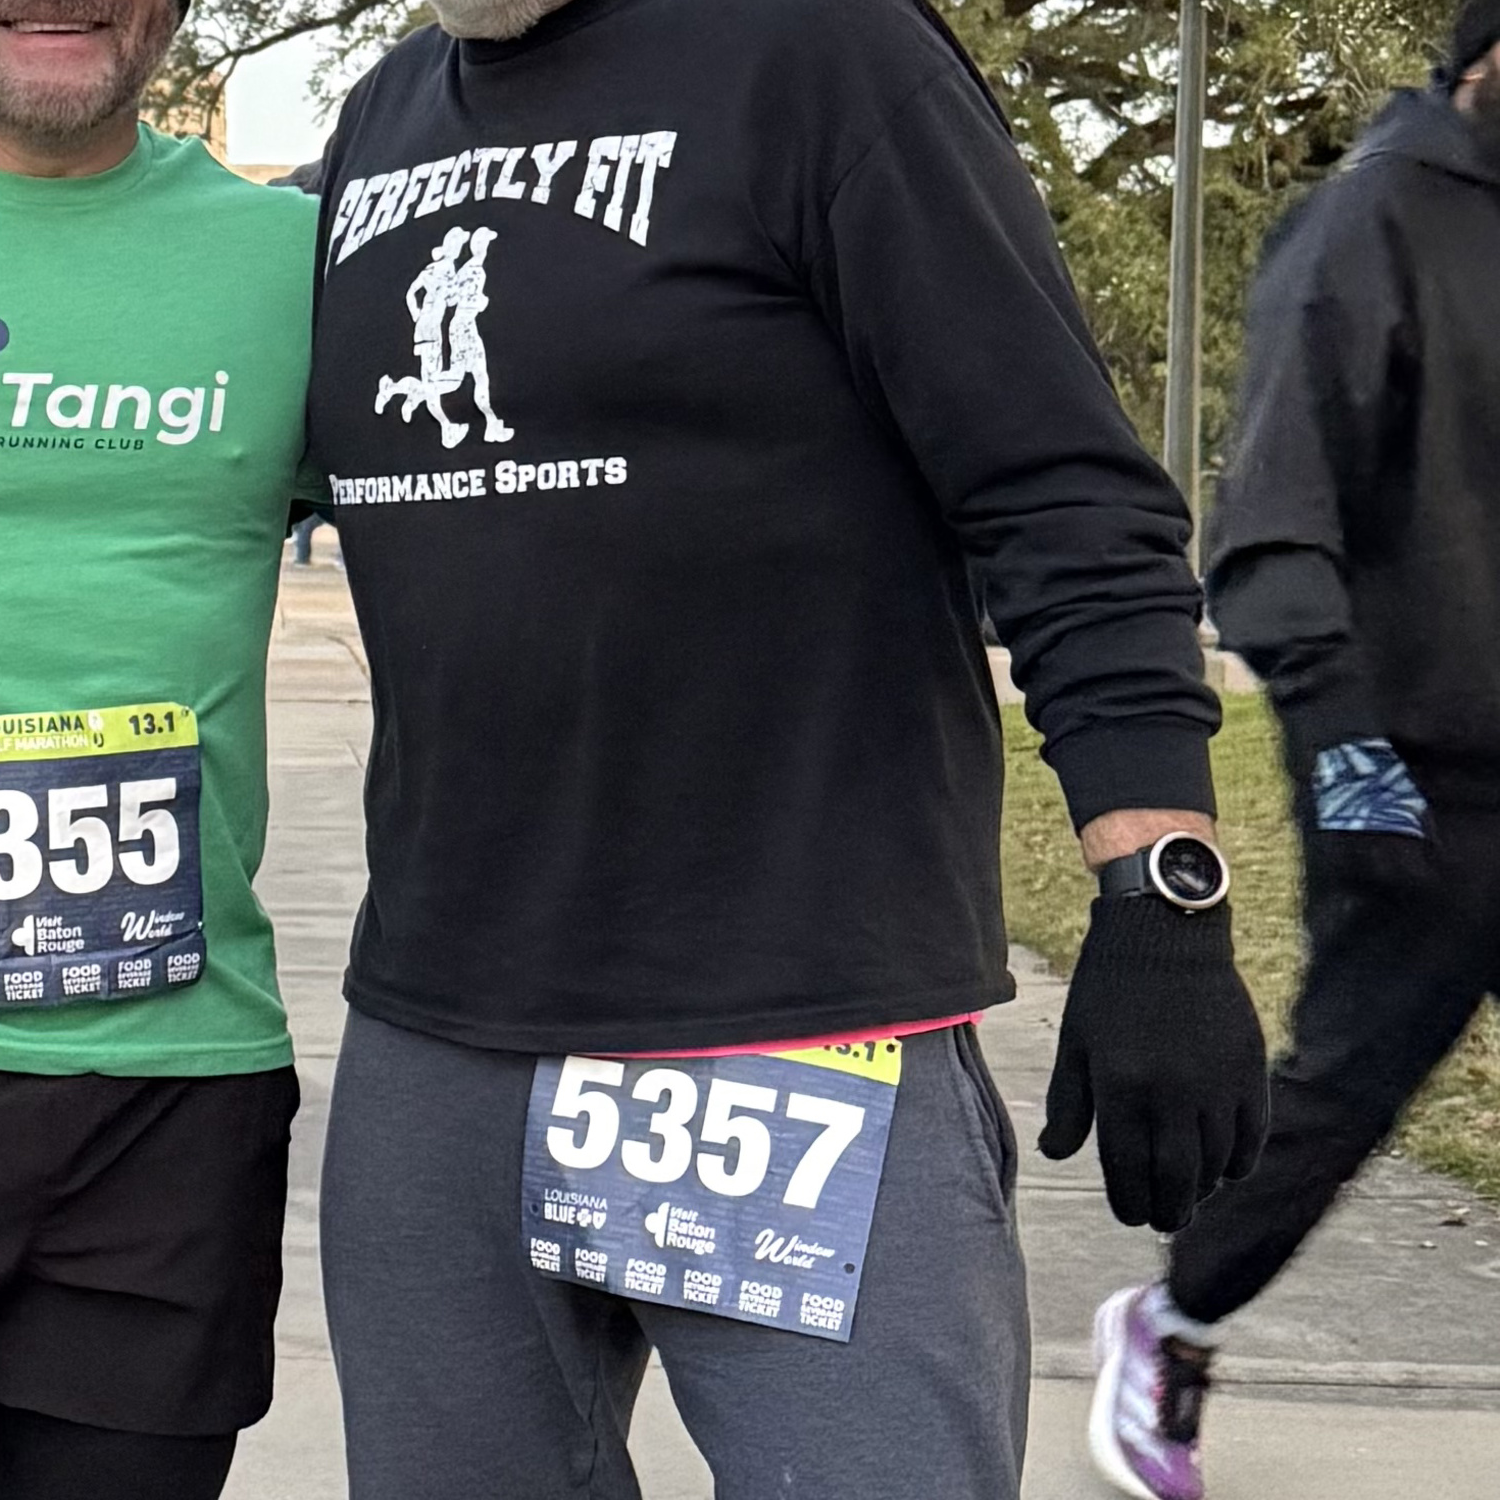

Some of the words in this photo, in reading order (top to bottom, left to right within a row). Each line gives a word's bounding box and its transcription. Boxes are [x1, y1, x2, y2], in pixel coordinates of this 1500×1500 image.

[324, 140, 578, 283] PERFECTLY
[574, 130, 678, 247] FIT
[2, 370, 229, 446] Tangi
[94, 437, 145, 451] CLUB
[328, 469, 487, 506] PERFORMANCE
[494, 456, 627, 494] SPORTS
[128, 711, 175, 736] 13.1
[16, 732, 88, 750] MARATHON
[36, 915, 63, 928] Visit
[36, 926, 82, 941] Baton
[37, 938, 85, 953] Rouge
[118, 958, 152, 972] FOOD
[167, 952, 201, 967] FOOD
[4, 971, 43, 985] FOOD
[62, 964, 101, 979] FOOD
[546, 1055, 866, 1209] 5357
[544, 1188, 608, 1211] LOUISIANA
[544, 1202, 576, 1225] BLUE
[668, 1218, 716, 1240] Baton
[530, 1237, 560, 1255] FOOD
[666, 1231, 716, 1255] Rouge
[575, 1248, 608, 1265] FOOD
[626, 1258, 667, 1277] FOOD
[684, 1269, 723, 1287] FOOD
[740, 1280, 783, 1299] FOOD
[801, 1292, 845, 1312] FOOD
